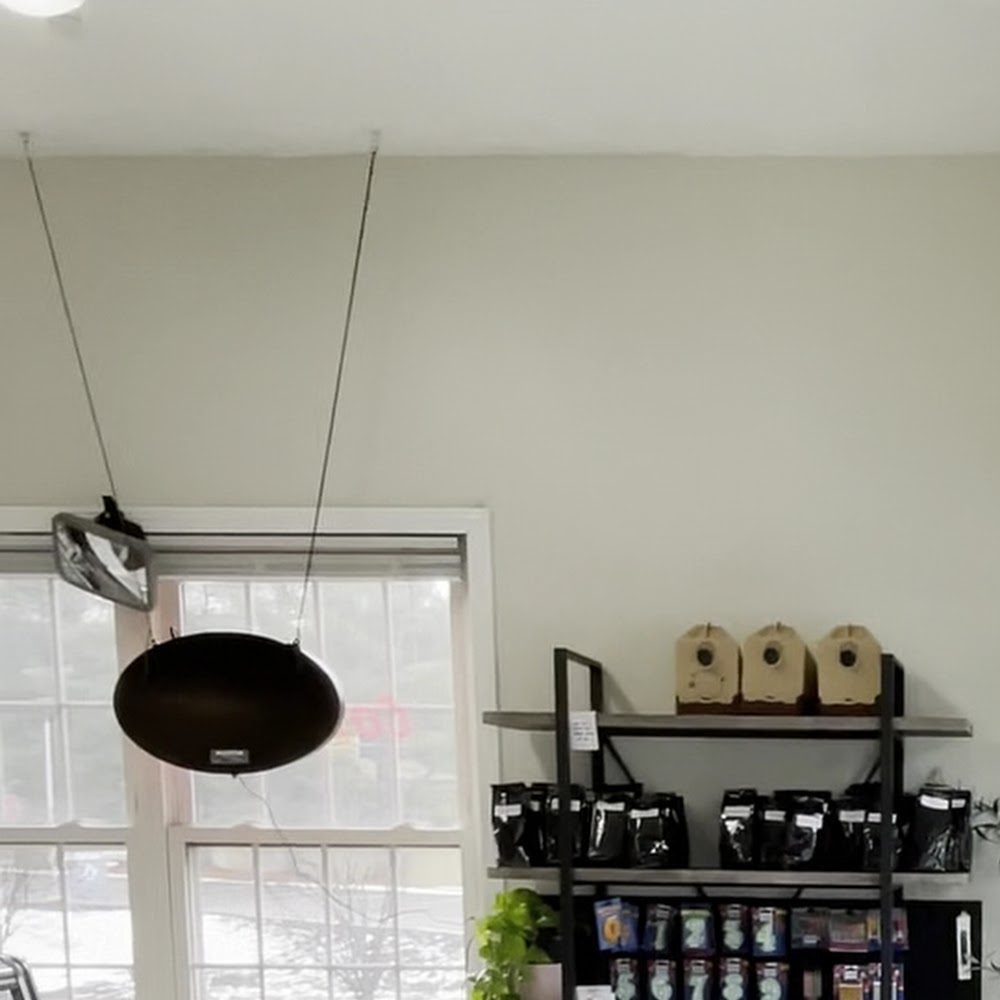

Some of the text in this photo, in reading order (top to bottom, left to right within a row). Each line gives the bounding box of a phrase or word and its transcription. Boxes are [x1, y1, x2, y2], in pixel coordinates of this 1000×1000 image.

[684, 918, 706, 949] 2
[723, 919, 744, 950] 3
[755, 911, 776, 952] 4
